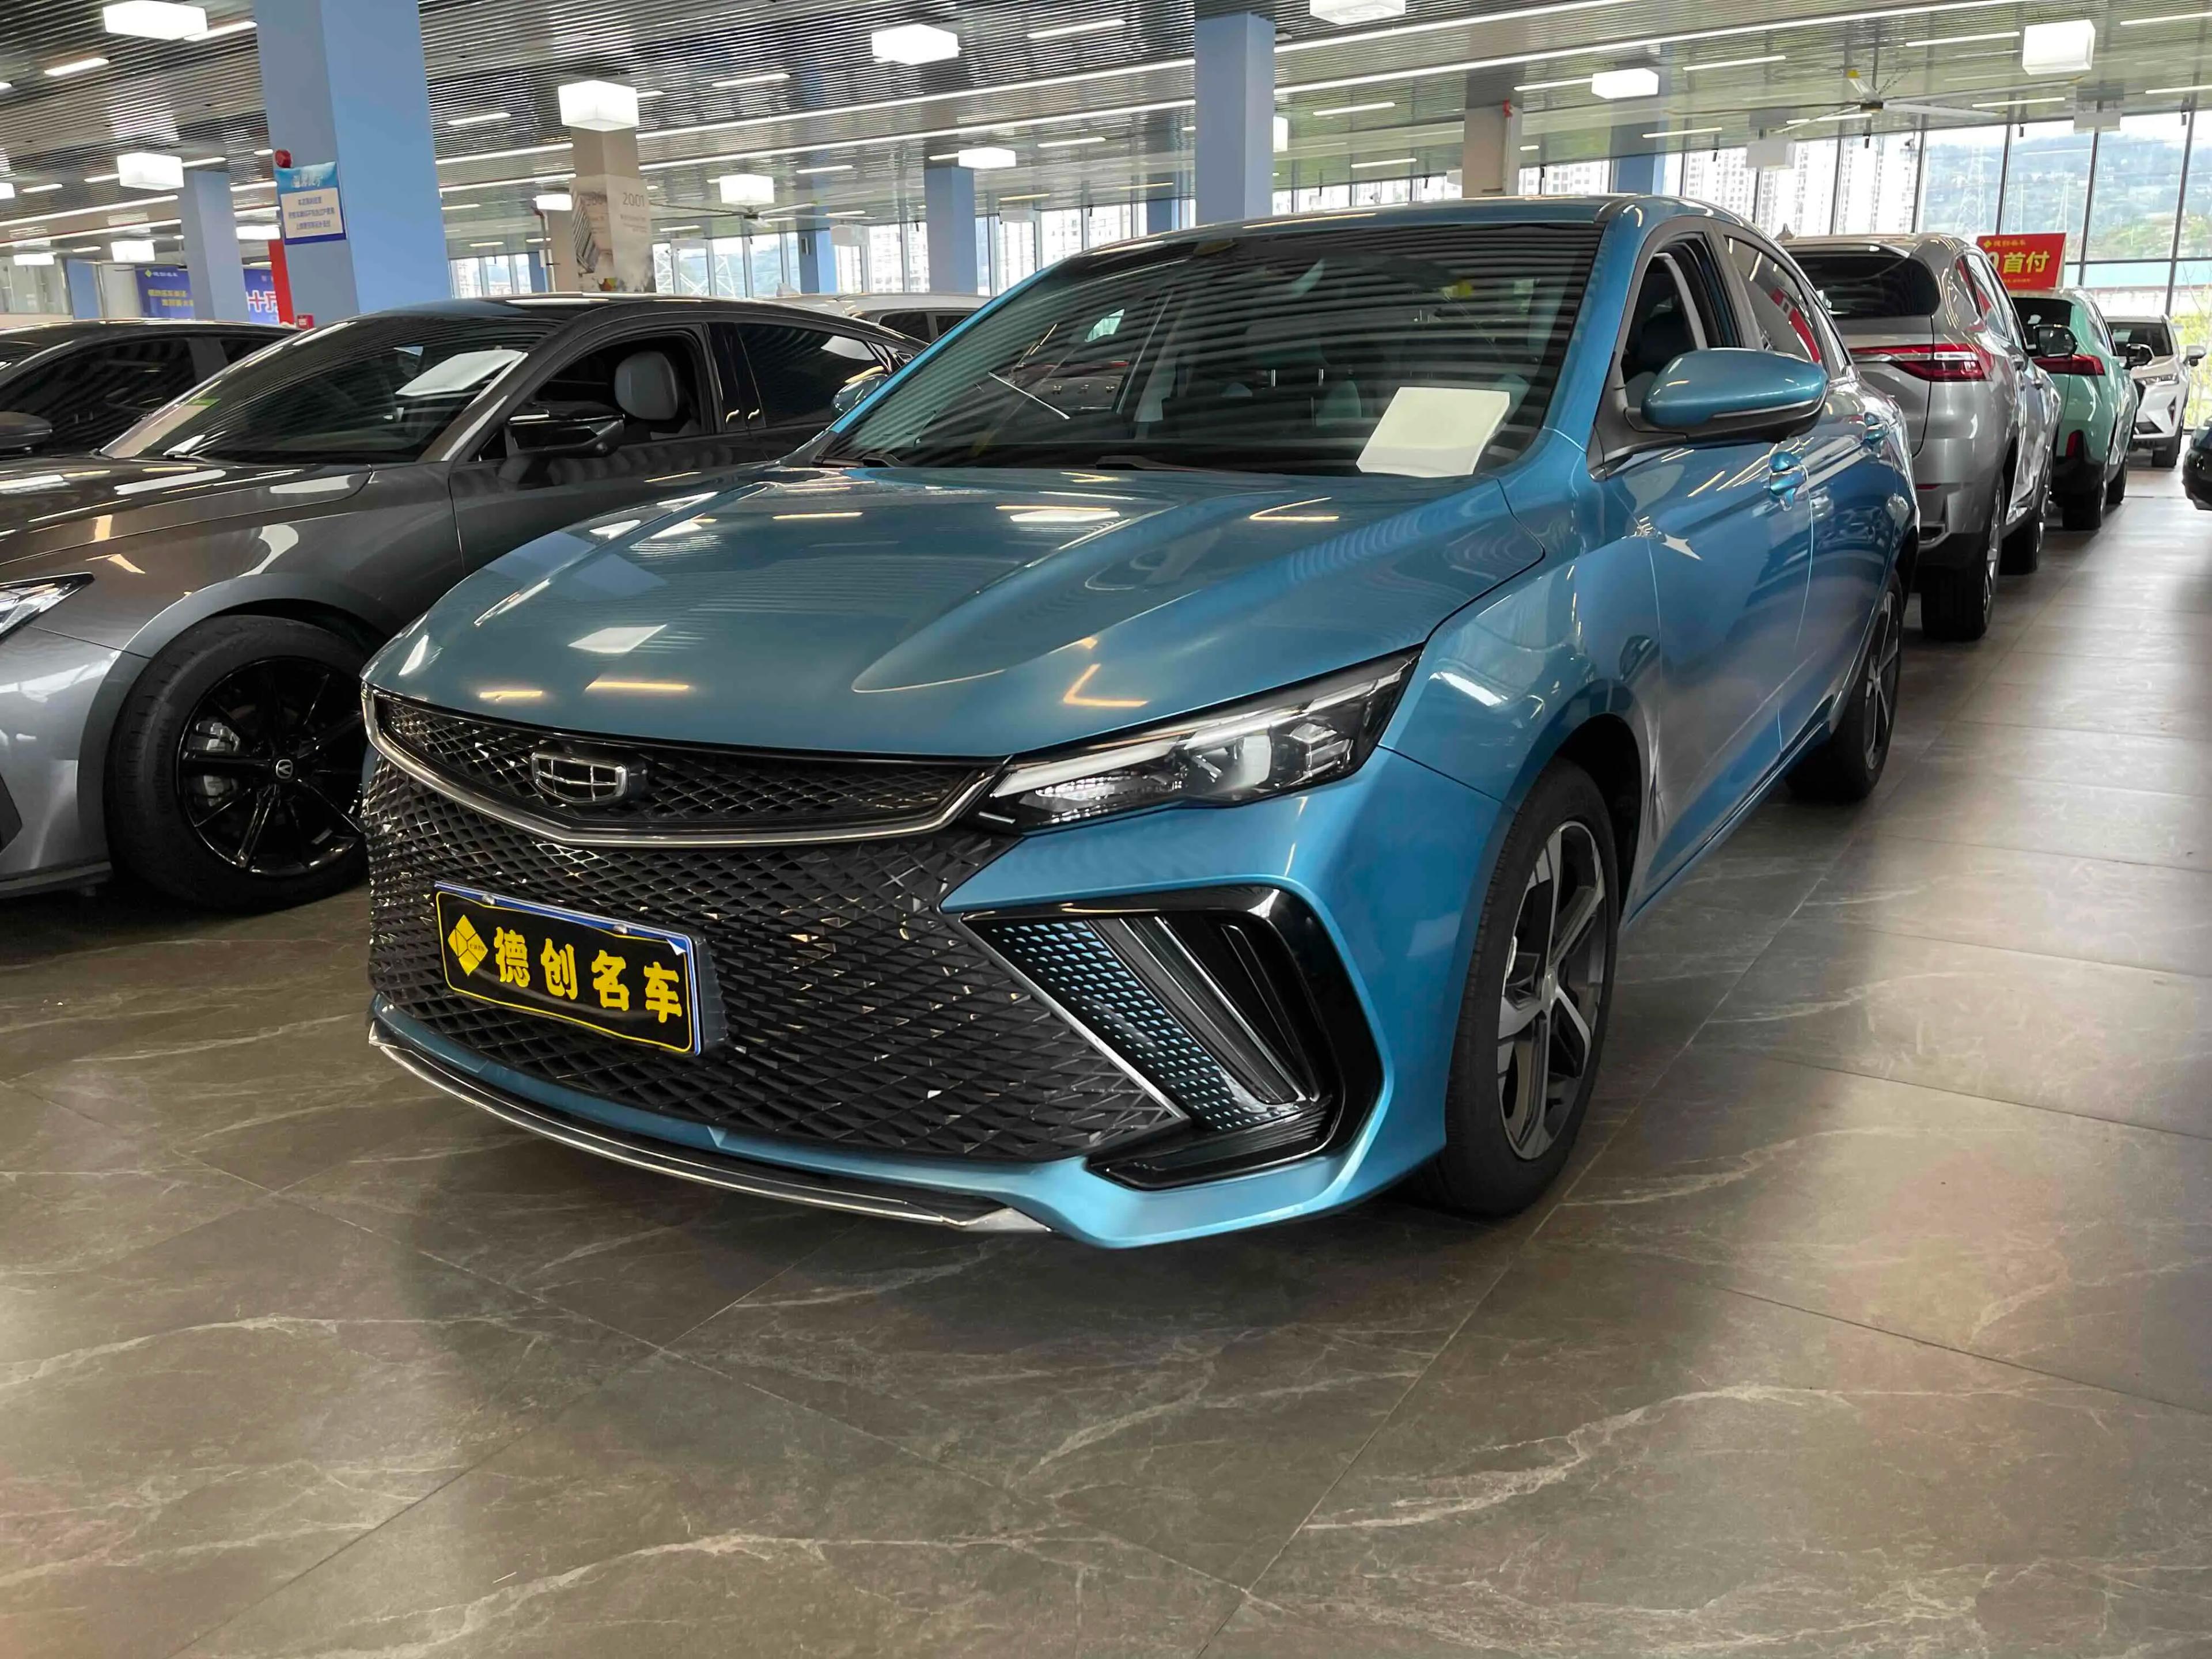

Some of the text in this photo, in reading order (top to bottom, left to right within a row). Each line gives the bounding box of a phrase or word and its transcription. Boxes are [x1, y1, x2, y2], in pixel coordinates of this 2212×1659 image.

[623, 192, 645, 207] 2001
[494, 926, 682, 1024] 德创名车
